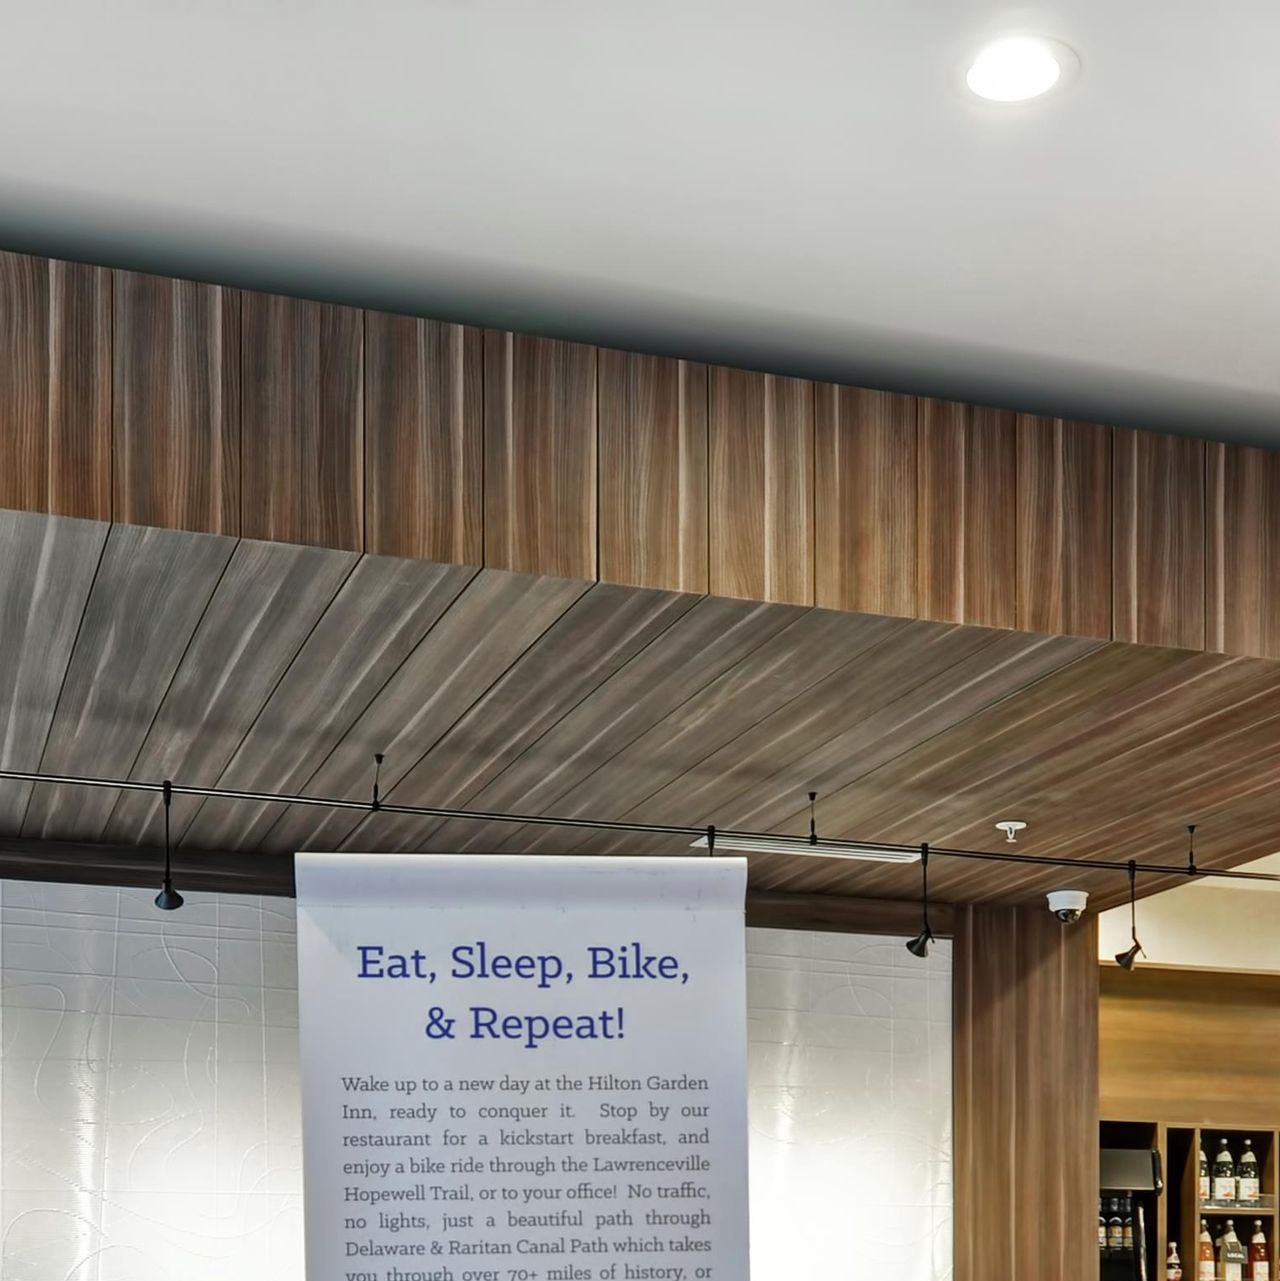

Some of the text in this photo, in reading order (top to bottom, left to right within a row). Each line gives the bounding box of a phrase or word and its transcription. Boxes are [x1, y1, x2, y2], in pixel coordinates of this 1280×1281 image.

[356, 941, 689, 989] Eat, Sleep, Bike,
[424, 1006, 624, 1049] & Repeat!
[341, 1074, 709, 1096] Wake up to a new day at the Hilton Garden
[342, 1101, 710, 1123] Inn, ready to conquer it. Stop by our
[342, 1128, 709, 1147] restaurant for a kickstart breakfast, and
[343, 1154, 710, 1178] enjoy a bike ride through the Lawrenceville
[344, 1181, 710, 1205] Hopewell Trail, or to your office! No traffic,
[344, 1208, 711, 1233] no lights, just a beautiful path through
[345, 1235, 712, 1256] Delaware & Raritan Canal Path which takes
[462, 1271, 500, 1281] over
[546, 1264, 592, 1280] miles
[600, 1263, 616, 1280] of
[694, 1267, 712, 1279] or
